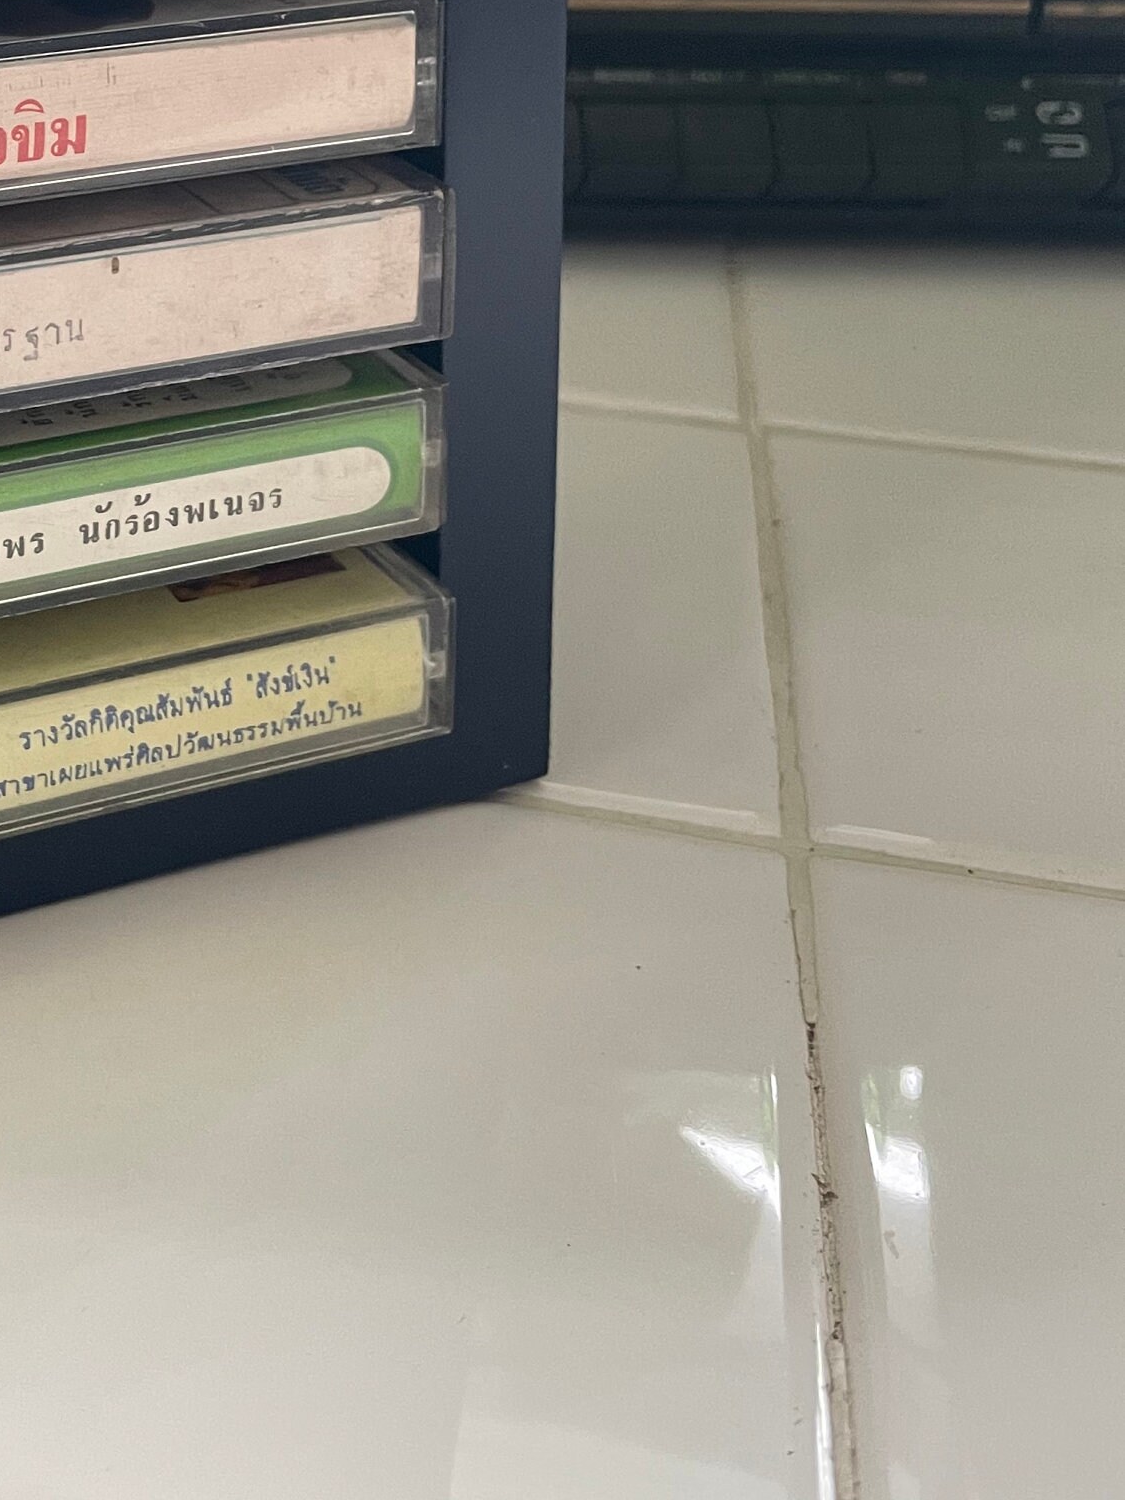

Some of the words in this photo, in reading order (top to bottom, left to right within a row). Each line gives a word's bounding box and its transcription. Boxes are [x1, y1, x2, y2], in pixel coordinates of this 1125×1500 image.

[78, 485, 283, 545] นักร้องพเนจร
